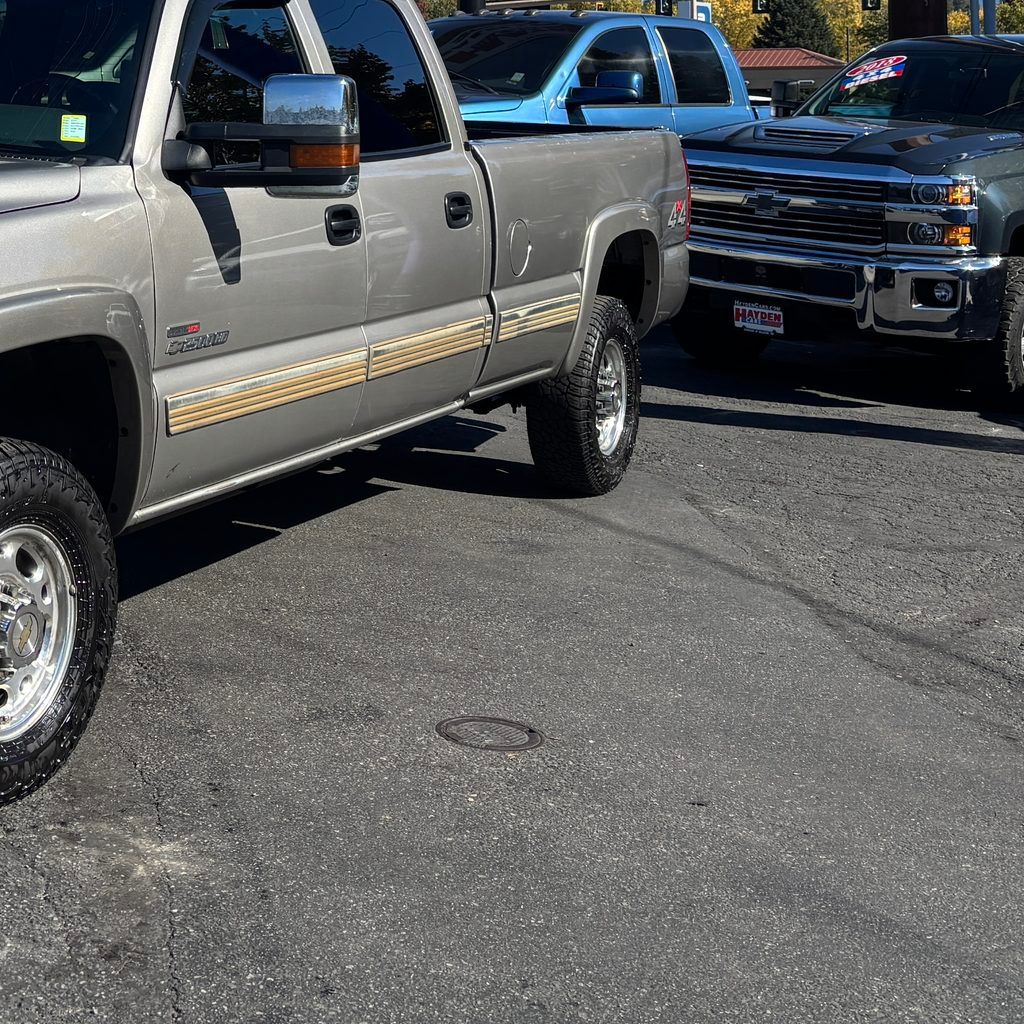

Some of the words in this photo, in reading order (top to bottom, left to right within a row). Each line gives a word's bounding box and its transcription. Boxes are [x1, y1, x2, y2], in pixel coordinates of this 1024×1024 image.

[858, 57, 896, 74] 2018
[844, 71, 897, 90] DIESEL
[735, 308, 781, 322] HAYDEN
